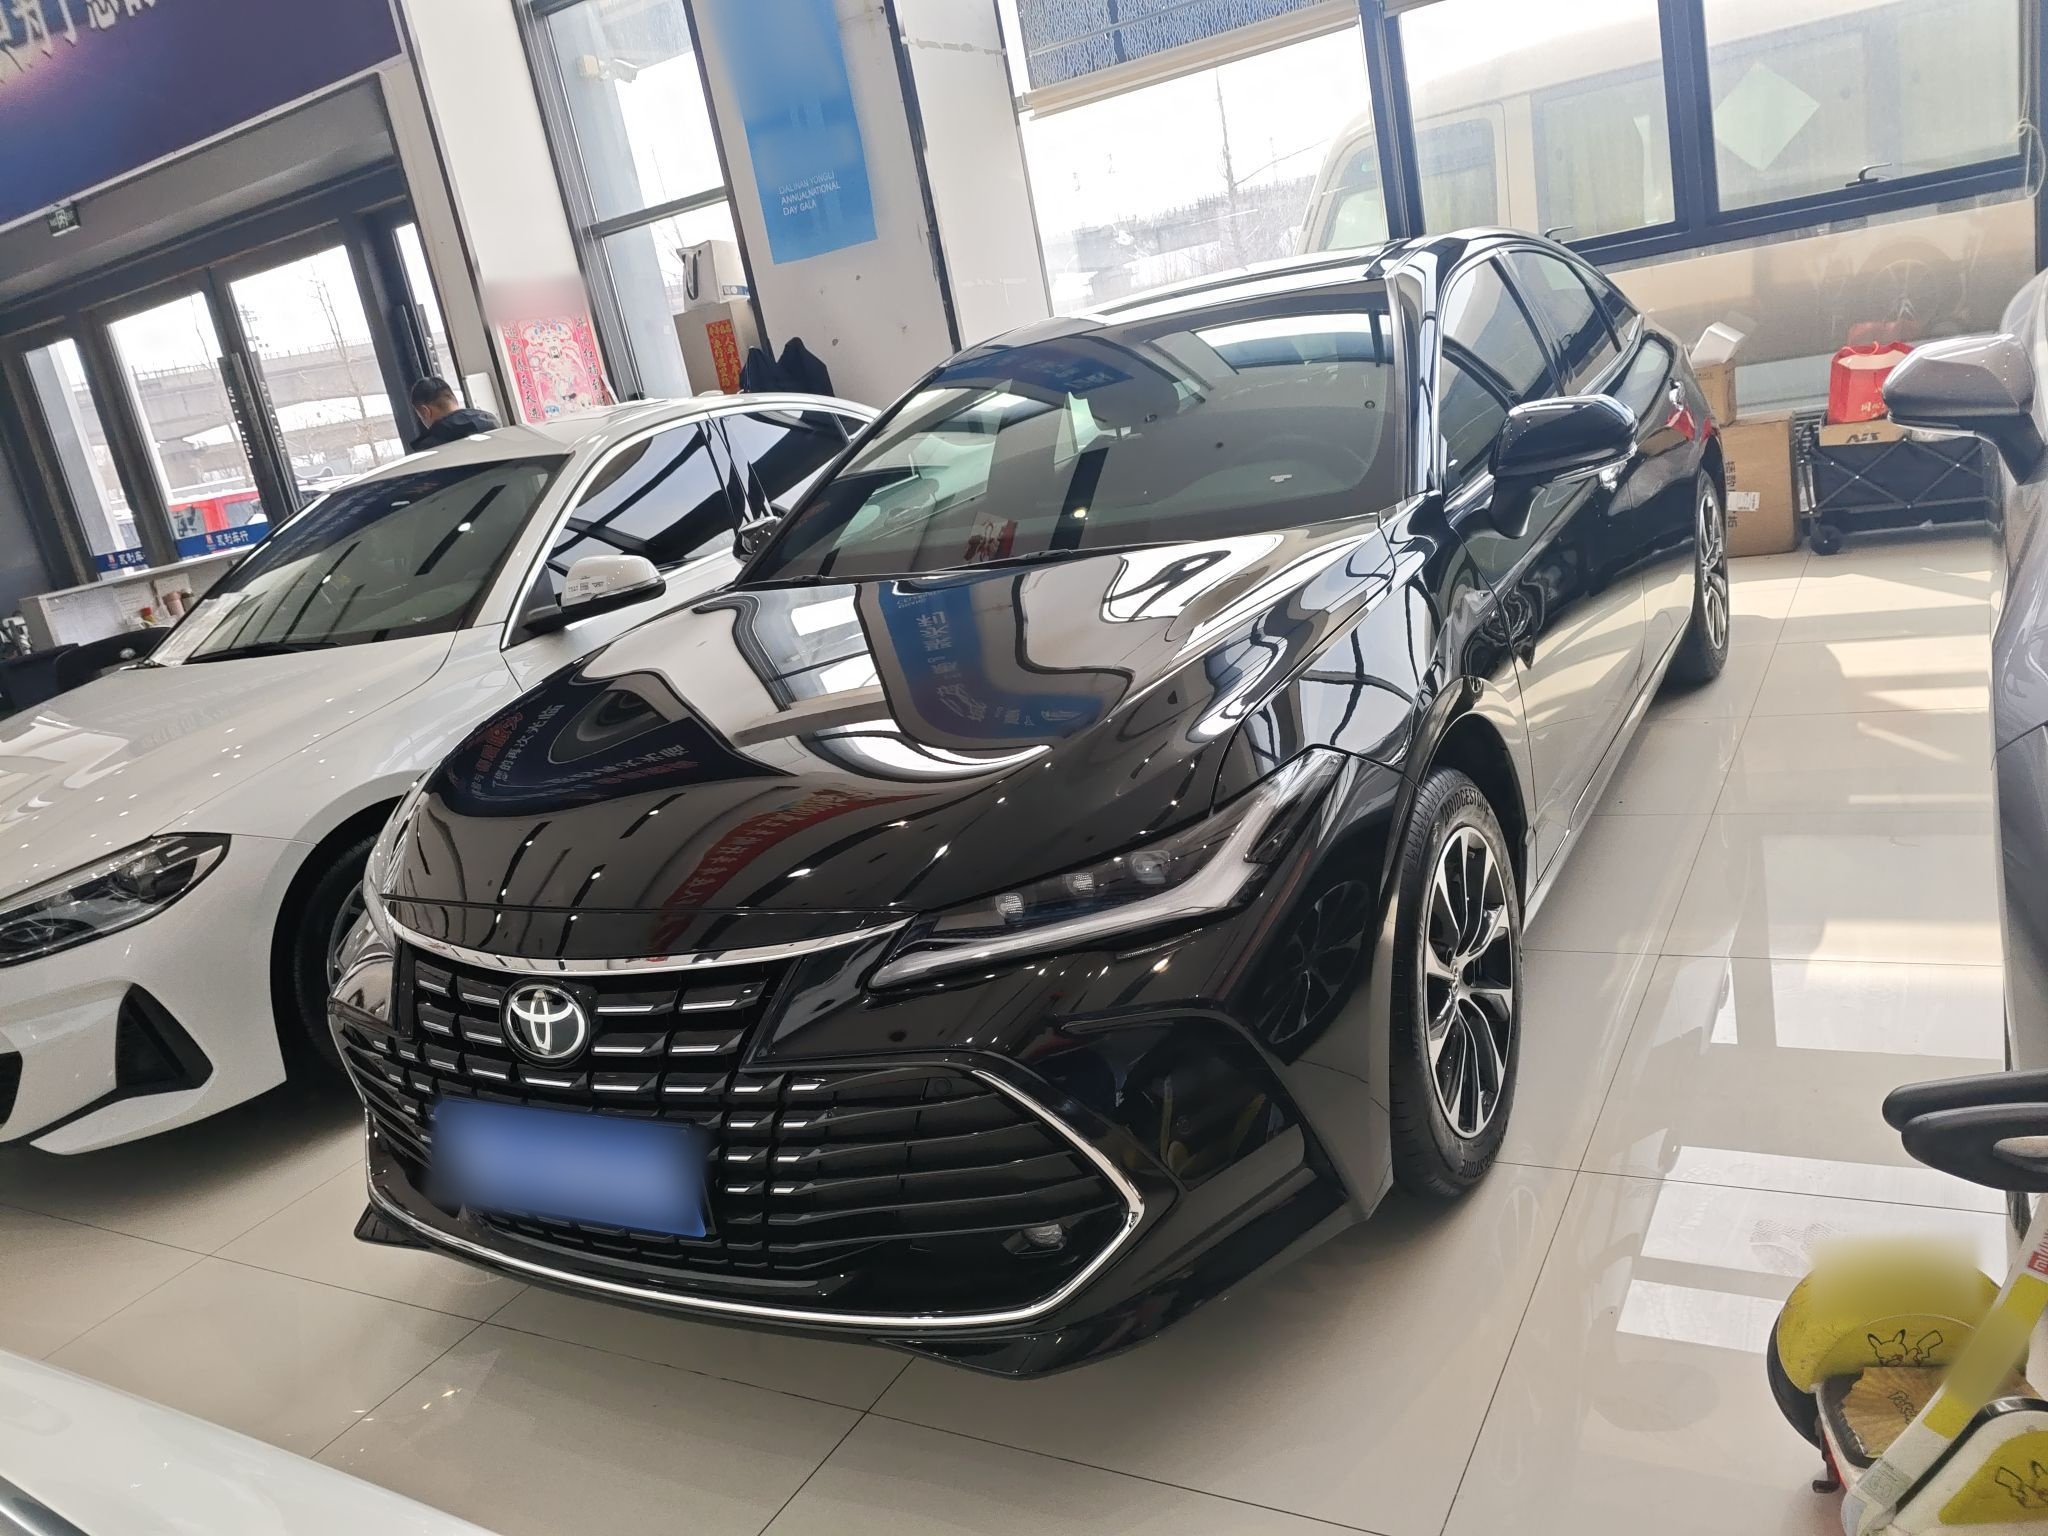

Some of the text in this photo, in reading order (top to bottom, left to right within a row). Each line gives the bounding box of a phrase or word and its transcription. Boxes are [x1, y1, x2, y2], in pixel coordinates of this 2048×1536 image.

[782, 200, 817, 216] DAY GALA
[1441, 788, 1489, 828] BRIDGESTONE
